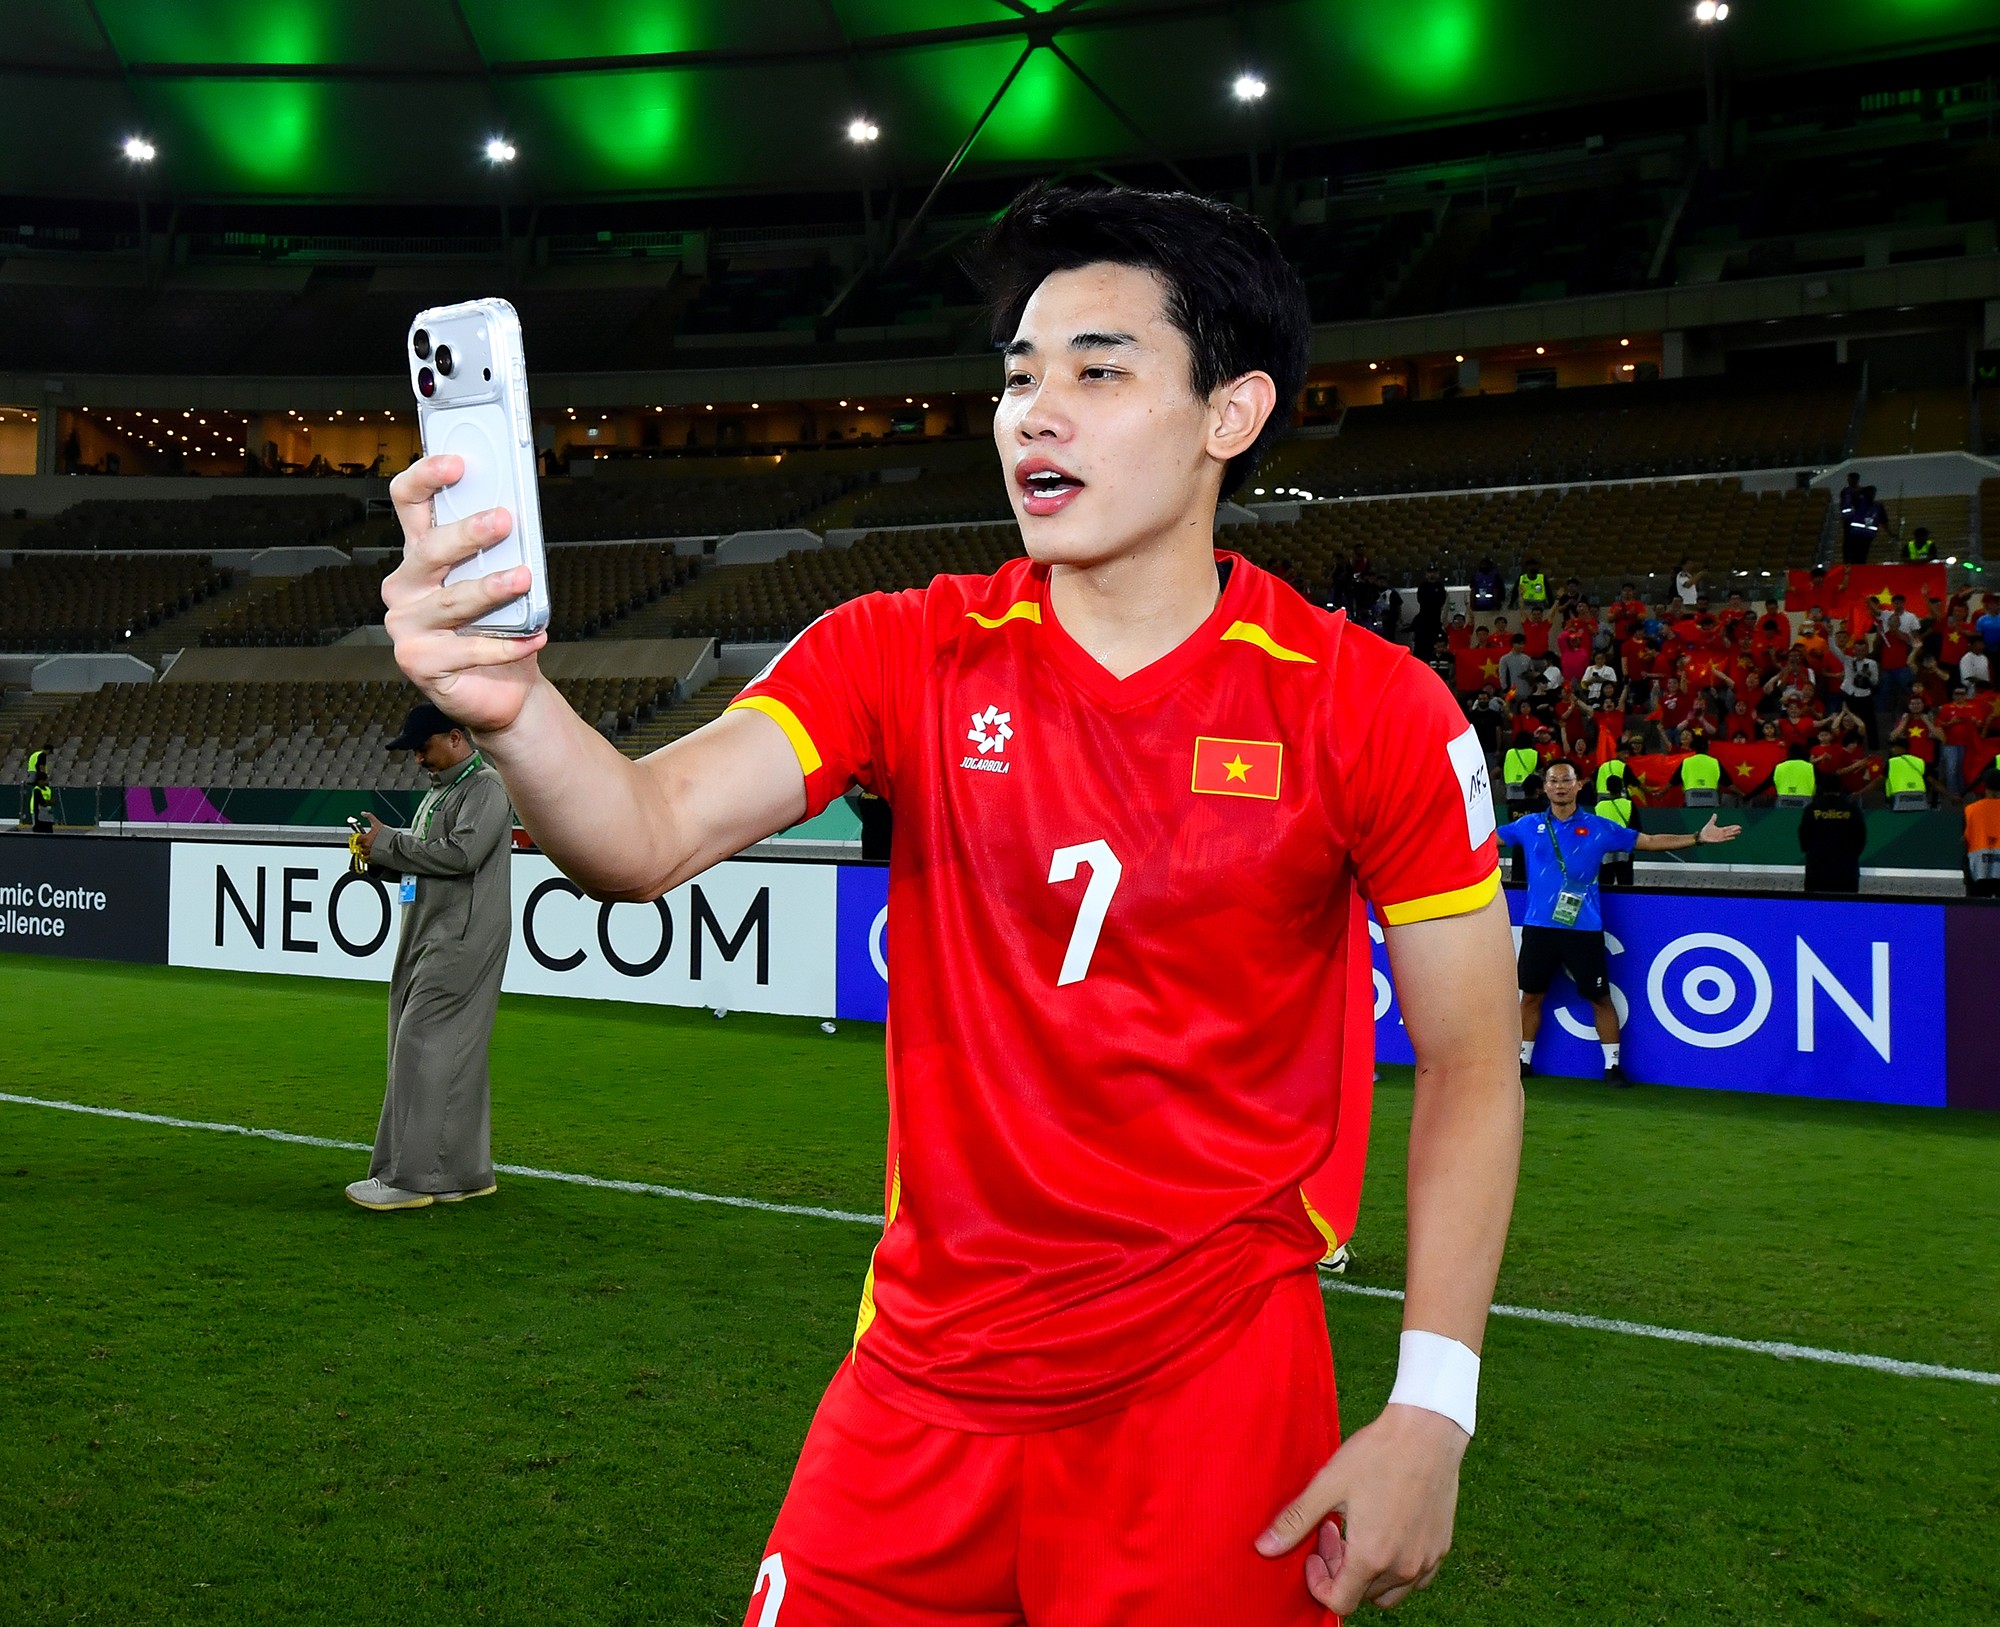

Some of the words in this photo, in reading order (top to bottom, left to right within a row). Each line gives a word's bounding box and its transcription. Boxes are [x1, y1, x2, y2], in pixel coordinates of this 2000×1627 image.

[960, 756, 1010, 774] JOGARBOLA
[1813, 809, 1851, 820] Police
[38, 883, 107, 911] Centre
[1047, 838, 1123, 987] 7
